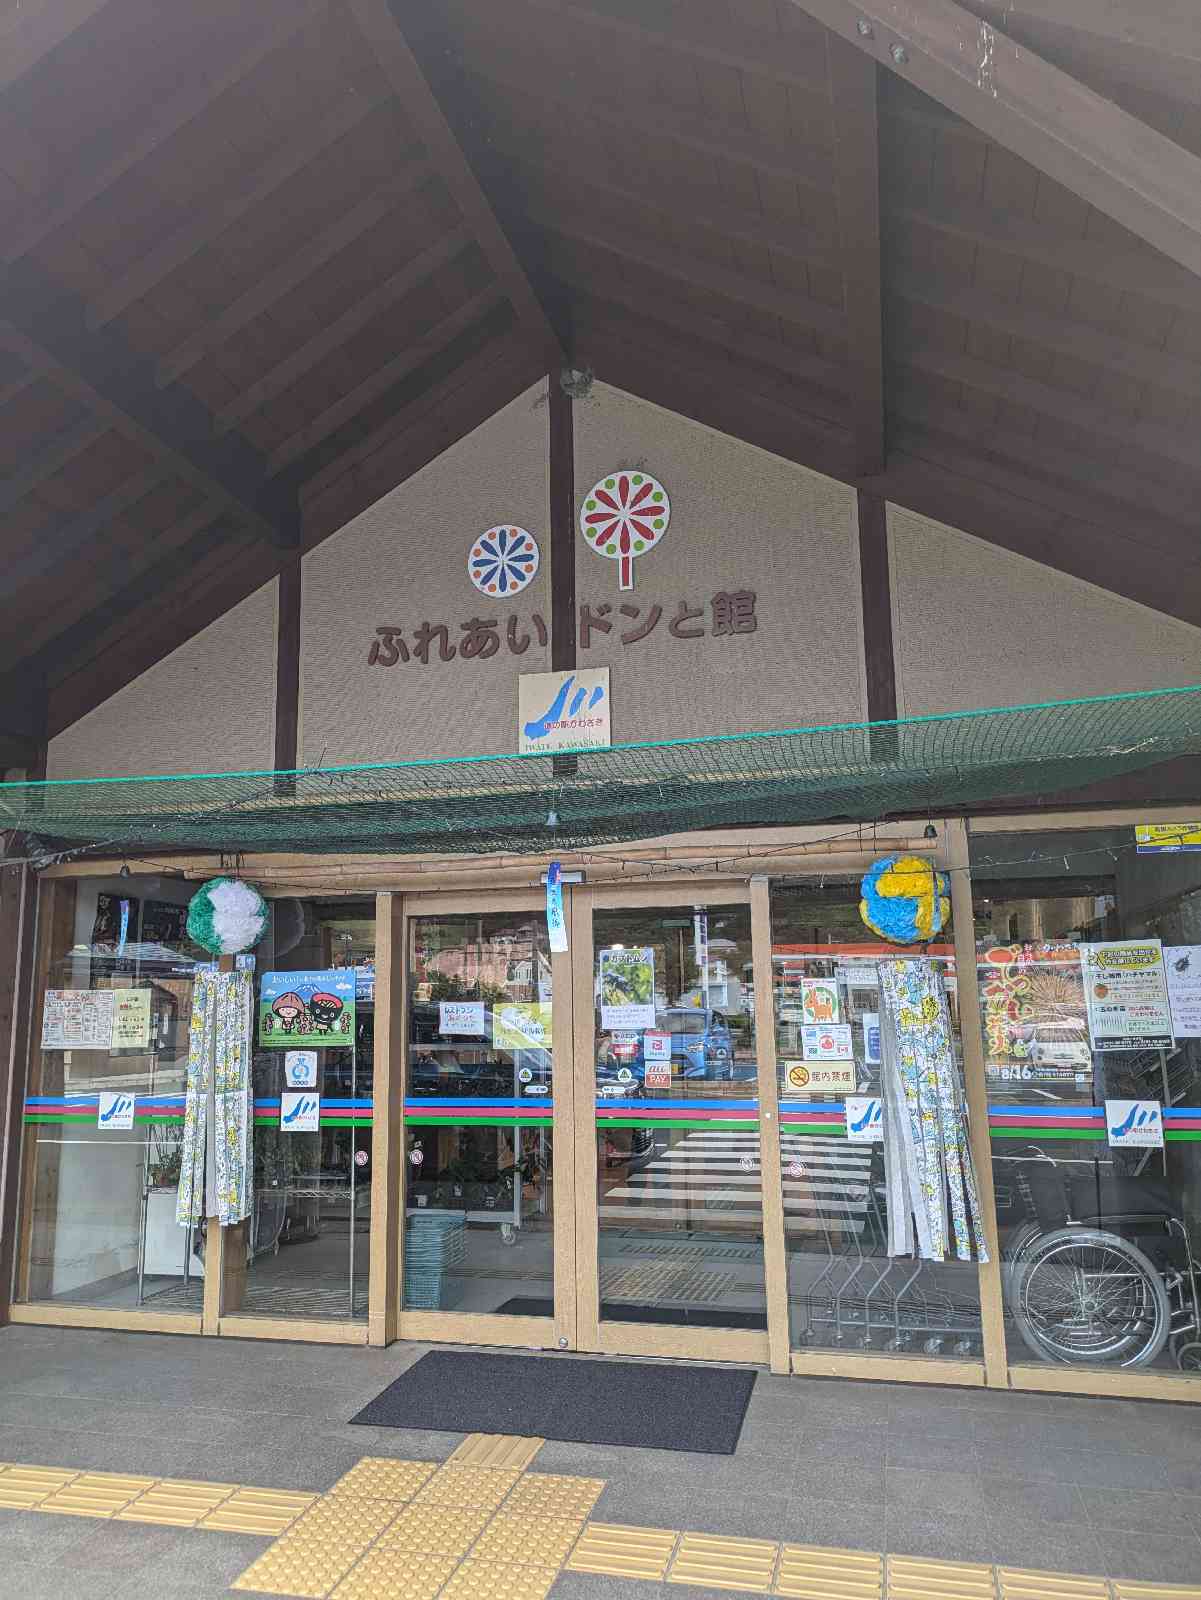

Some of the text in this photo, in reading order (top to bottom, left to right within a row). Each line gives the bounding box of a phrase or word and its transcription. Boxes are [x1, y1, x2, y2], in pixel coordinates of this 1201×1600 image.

[367, 590, 757, 667] ふれあい ドンと館
